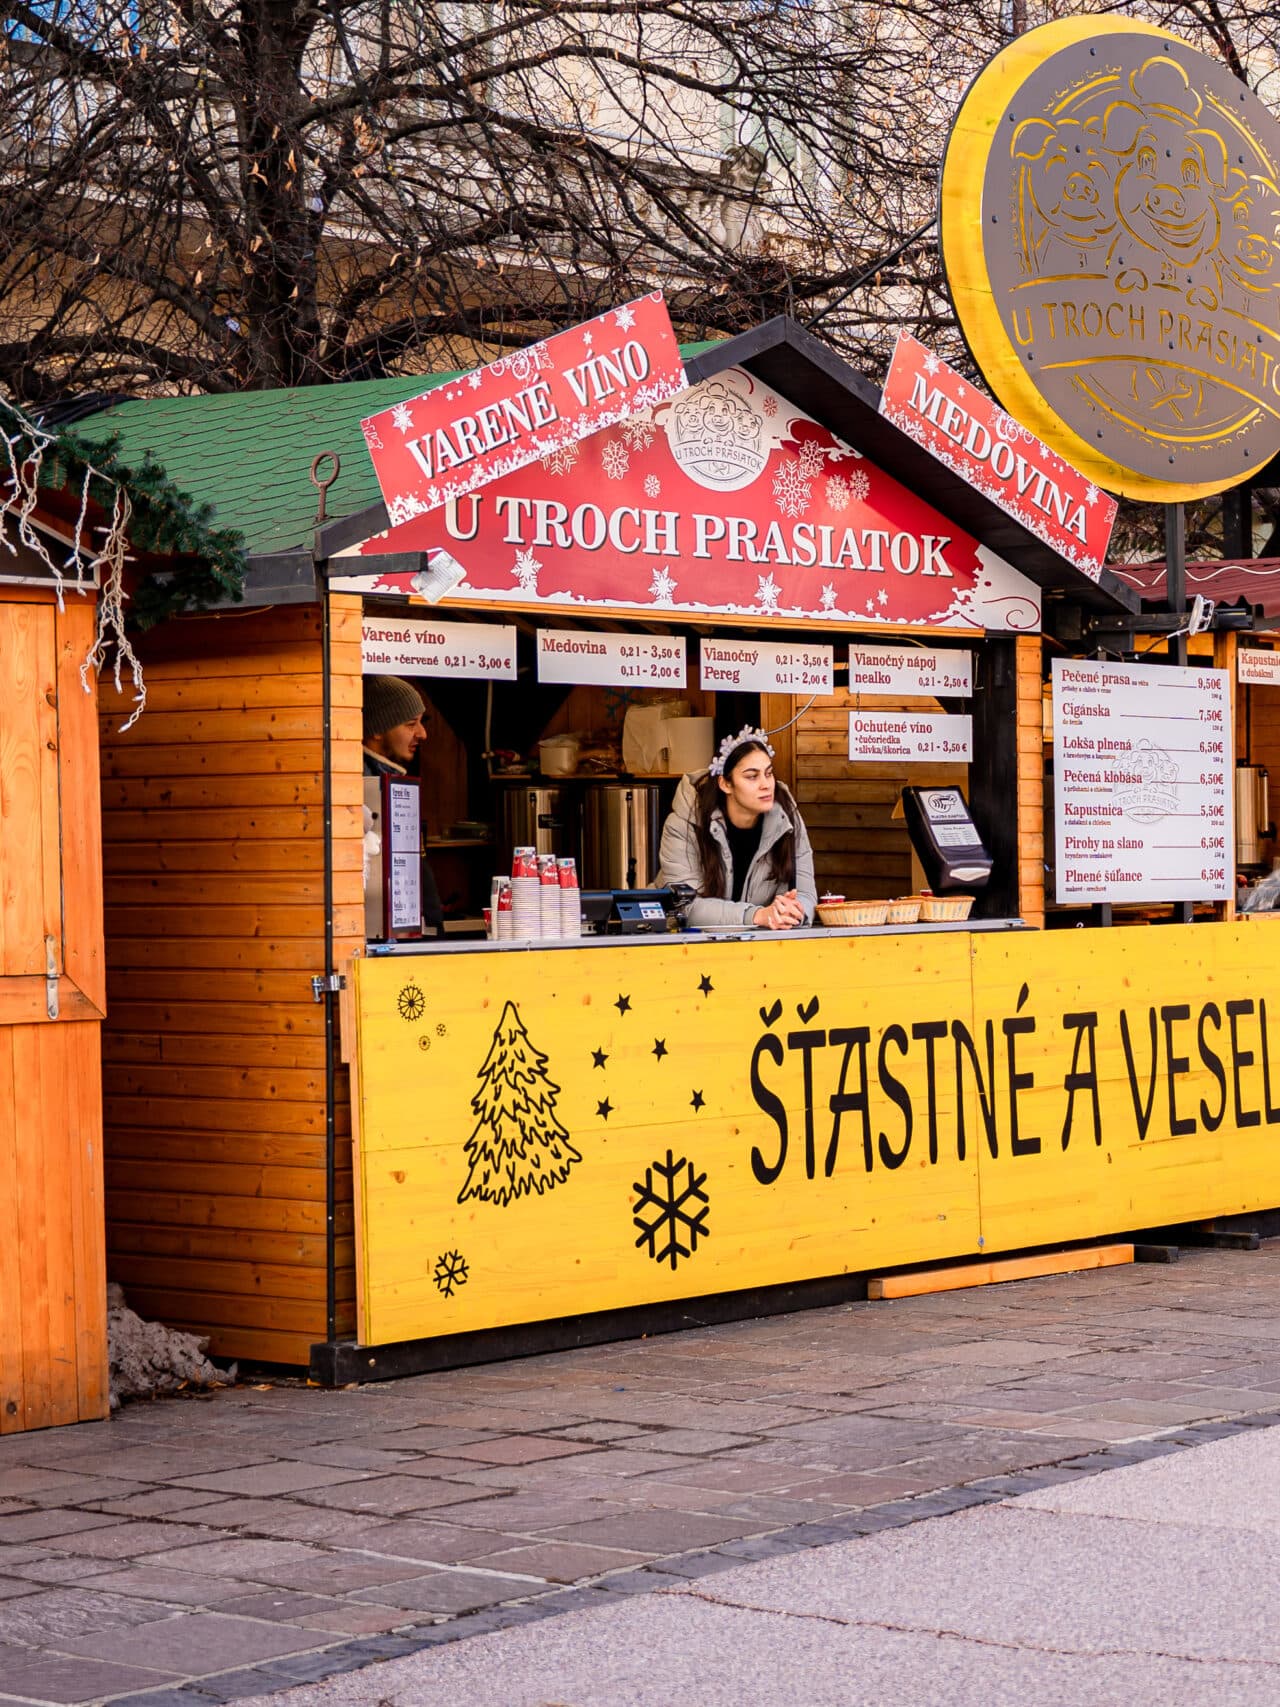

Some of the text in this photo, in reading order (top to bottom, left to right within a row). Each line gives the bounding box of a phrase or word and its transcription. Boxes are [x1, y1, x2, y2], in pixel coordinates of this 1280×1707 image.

[1012, 306, 1032, 347] U
[1042, 302, 1145, 342] TROCH
[405, 340, 651, 482] VARENÉ VÍNO
[675, 446, 762, 470] U TROCH PRASIATOK
[907, 371, 1089, 546] MEDOVINA
[443, 494, 953, 578] U TROCH PRASIATOK
[361, 626, 446, 645] Varené víno
[542, 638, 607, 656] Medovina
[651, 645, 673, 660] 3,50
[673, 648, 681, 659] €
[366, 652, 439, 665] biele červené
[478, 655, 502, 669] 3,00
[503, 658, 511, 669] €
[704, 647, 759, 665] Vianočný
[803, 654, 822, 667] 3,50
[823, 657, 829, 666] €
[854, 652, 937, 670] Vianočný nápoj
[651, 664, 673, 679] 2,00
[673, 667, 681, 678] €
[704, 666, 740, 684] Pereg
[802, 672, 821, 685] 2,00
[821, 675, 828, 685] €
[855, 671, 892, 685] nealko
[1062, 669, 1100, 683] Pečené
[1102, 674, 1131, 686] prasa
[943, 676, 962, 689] 2,50
[963, 678, 969, 688] €
[1198, 678, 1222, 690] 9,50€
[1062, 702, 1110, 718] Cigánska
[1199, 710, 1223, 722] 7,50€
[854, 719, 932, 734] Ochutené víno
[858, 735, 901, 745] čučoriedka
[943, 741, 961, 753] 3,50
[961, 743, 967, 753] €
[1063, 736, 1132, 752] Lokša plnená
[1200, 742, 1223, 754] 6,50€
[1064, 770, 1143, 784] Pečená klobása
[1200, 774, 1224, 786] 6,50€
[1064, 803, 1123, 818] Kapustnica
[1200, 805, 1224, 817] 5,50€
[1065, 836, 1144, 852] Pirohy na slano
[1201, 837, 1224, 849] 6,50€
[1065, 868, 1142, 882] Plnené šúľance
[1201, 869, 1224, 881] 6,50€
[750, 982, 1041, 1185] ŠŤASTNÉ
[1062, 1011, 1103, 1152] A
